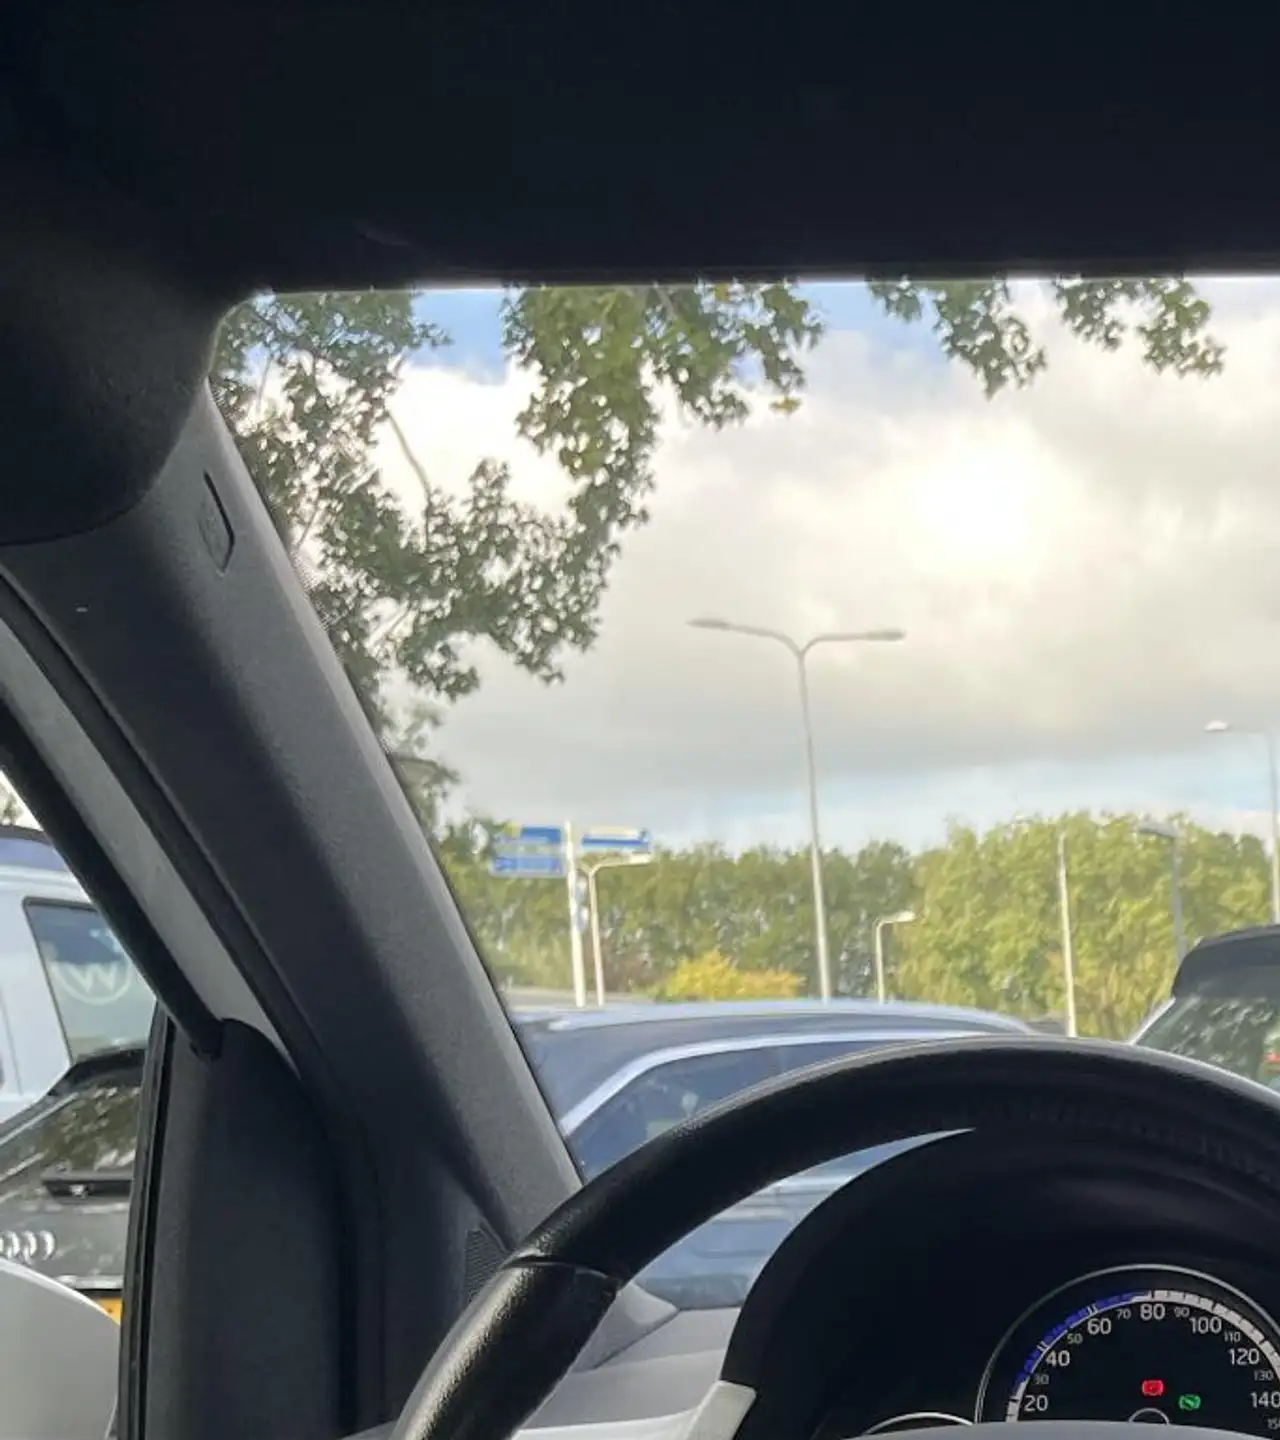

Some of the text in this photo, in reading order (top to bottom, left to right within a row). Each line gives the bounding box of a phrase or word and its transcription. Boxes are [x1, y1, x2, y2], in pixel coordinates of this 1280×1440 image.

[1117, 1308, 1131, 1320] 70
[1140, 1303, 1165, 1320] 80
[1174, 1306, 1189, 1318] 90
[1087, 1318, 1111, 1335] 60
[1189, 1316, 1222, 1334] 100
[1067, 1333, 1083, 1345] 50
[1224, 1331, 1241, 1343] 110
[1046, 1350, 1070, 1367] 40
[1229, 1348, 1259, 1365] 120
[1033, 1373, 1049, 1385] 30
[1254, 1370, 1273, 1381] 130
[1024, 1394, 1048, 1412] 20
